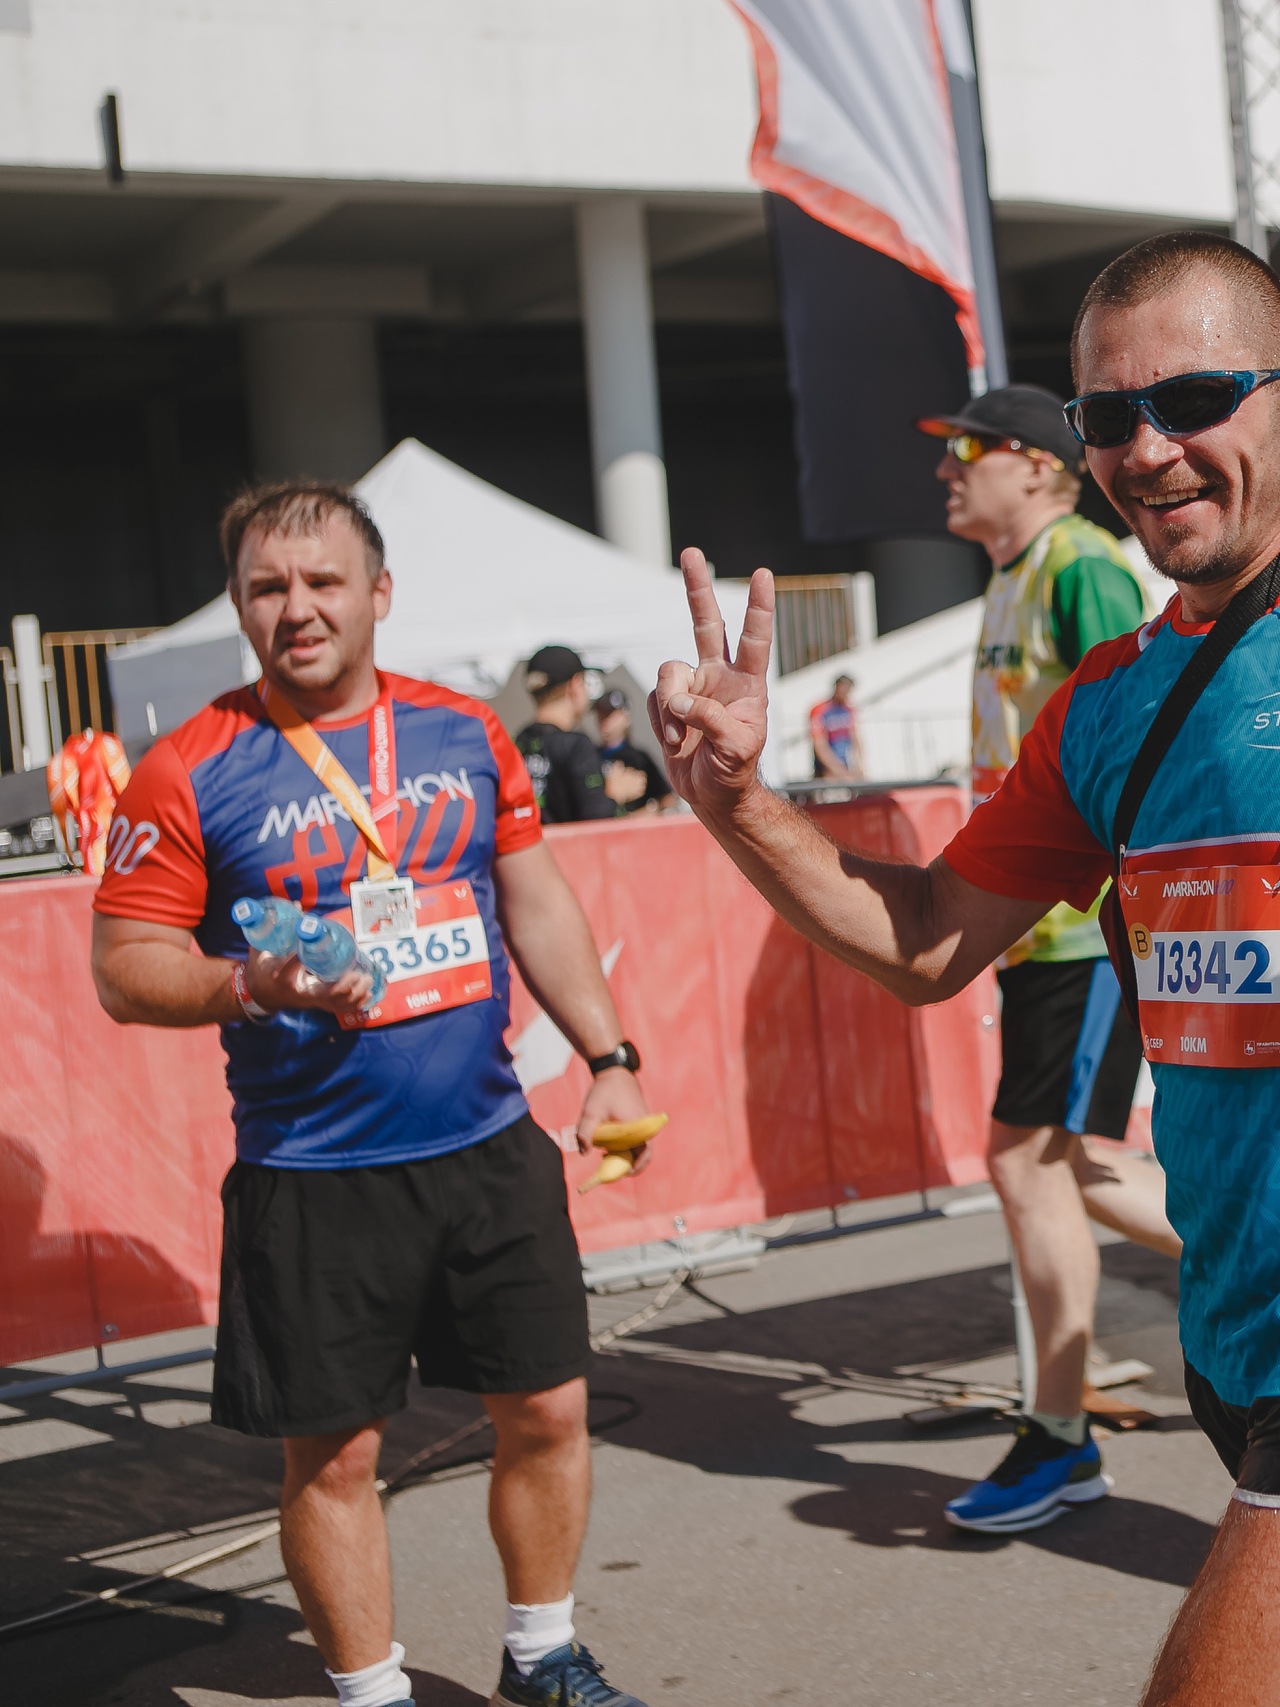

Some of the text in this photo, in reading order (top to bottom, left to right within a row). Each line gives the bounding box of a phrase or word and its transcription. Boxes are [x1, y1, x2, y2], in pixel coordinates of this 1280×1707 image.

[257, 767, 475, 844] MARHON
[1162, 879, 1215, 898] MARATHON
[1134, 930, 1149, 953] B
[1154, 939, 1273, 995] 13342
